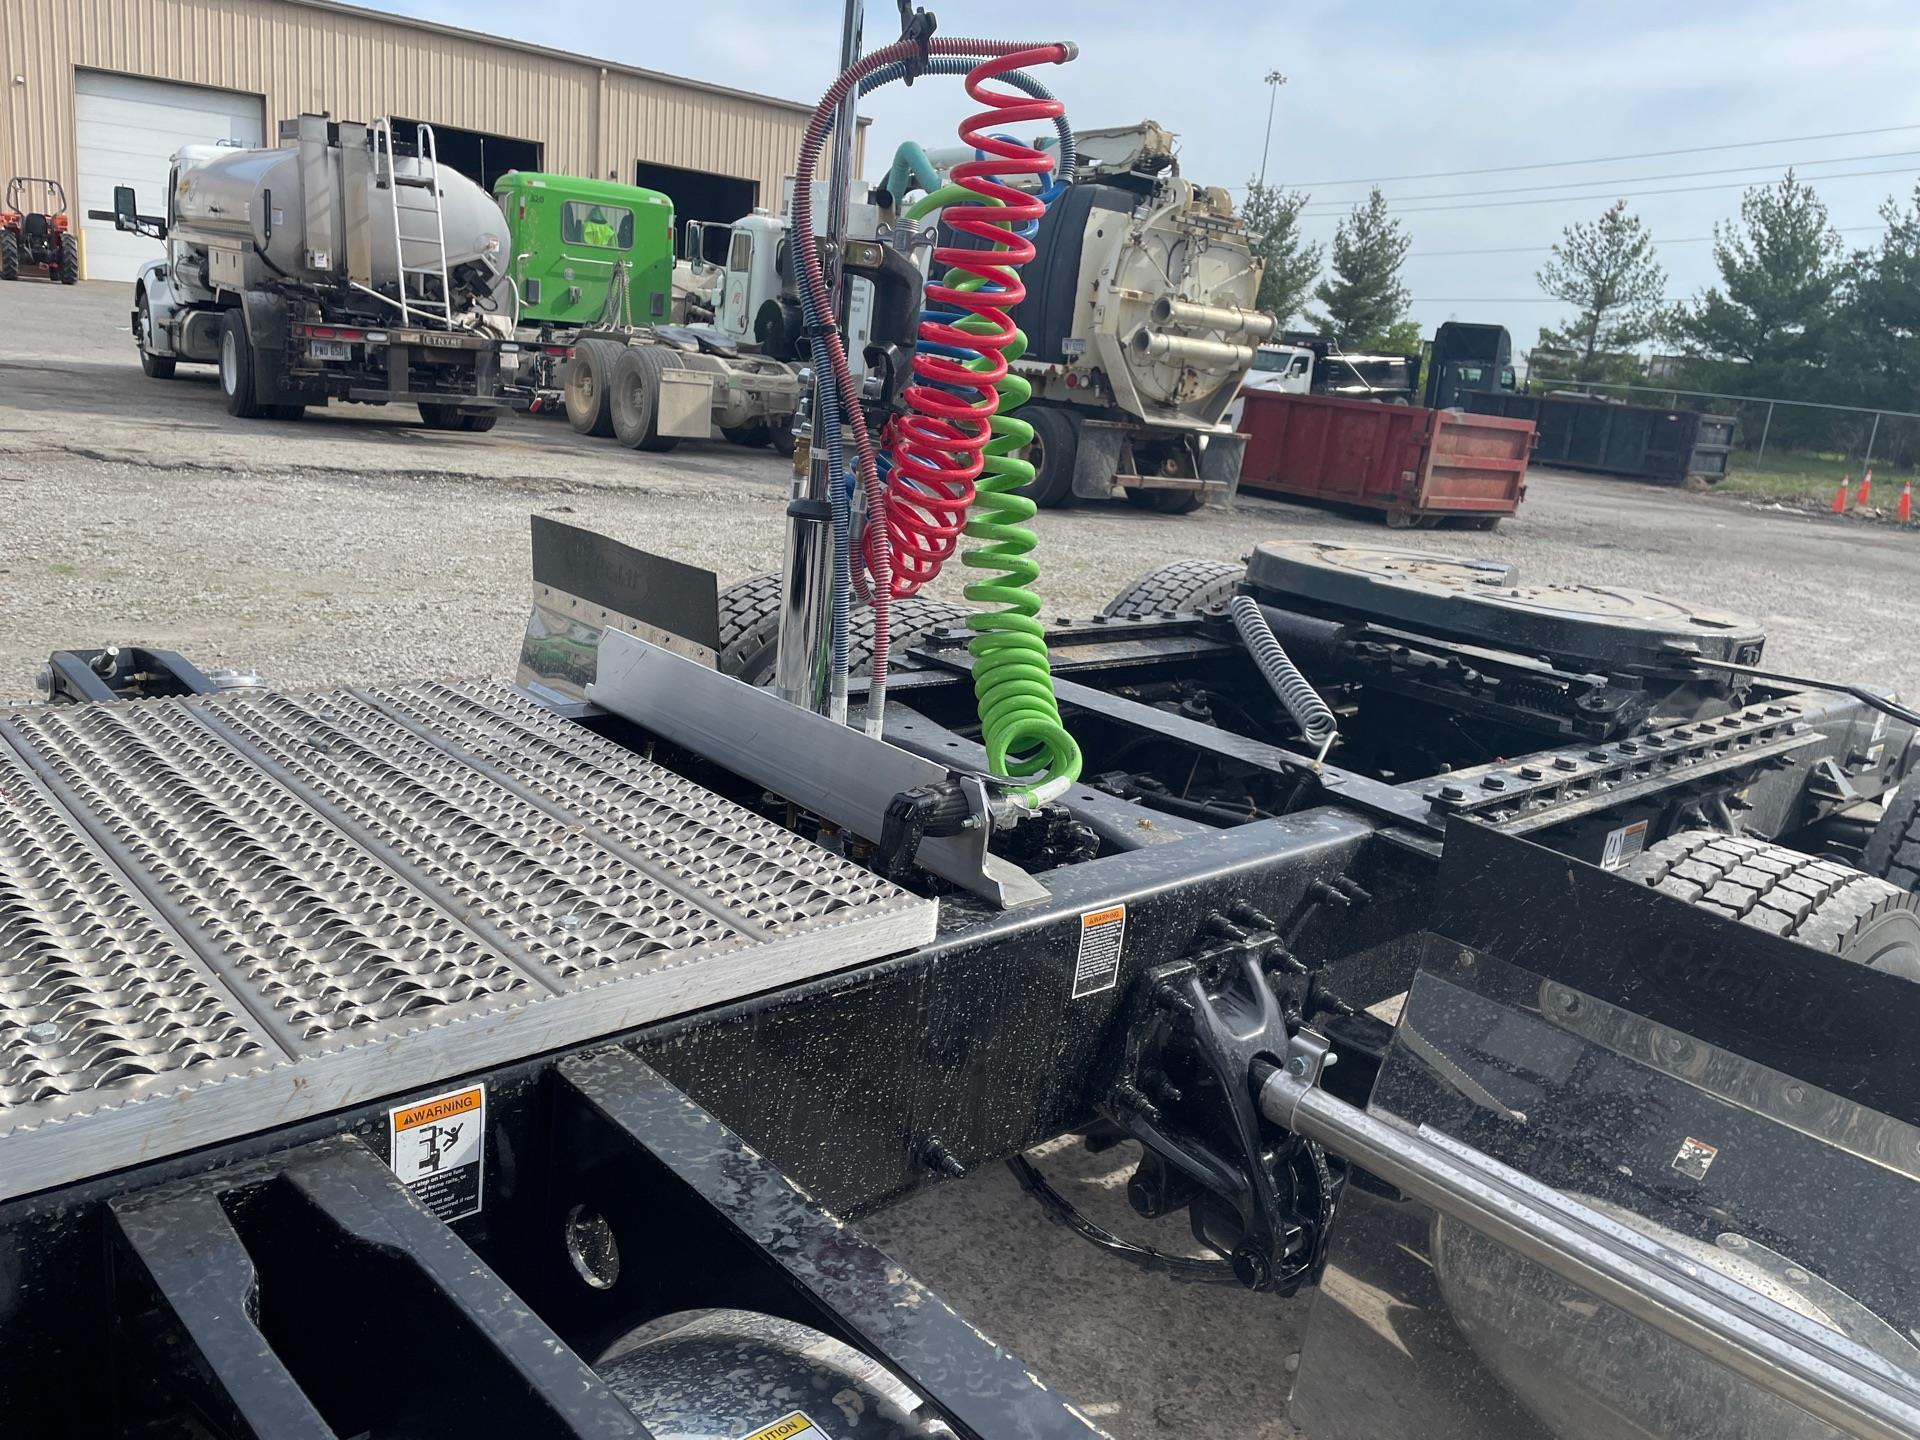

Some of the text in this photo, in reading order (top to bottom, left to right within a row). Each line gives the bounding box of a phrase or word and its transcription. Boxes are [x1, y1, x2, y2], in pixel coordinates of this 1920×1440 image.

[414, 1097, 473, 1121] WARNING
[430, 1175, 439, 1183] on
[759, 1421, 798, 1440] UTION
